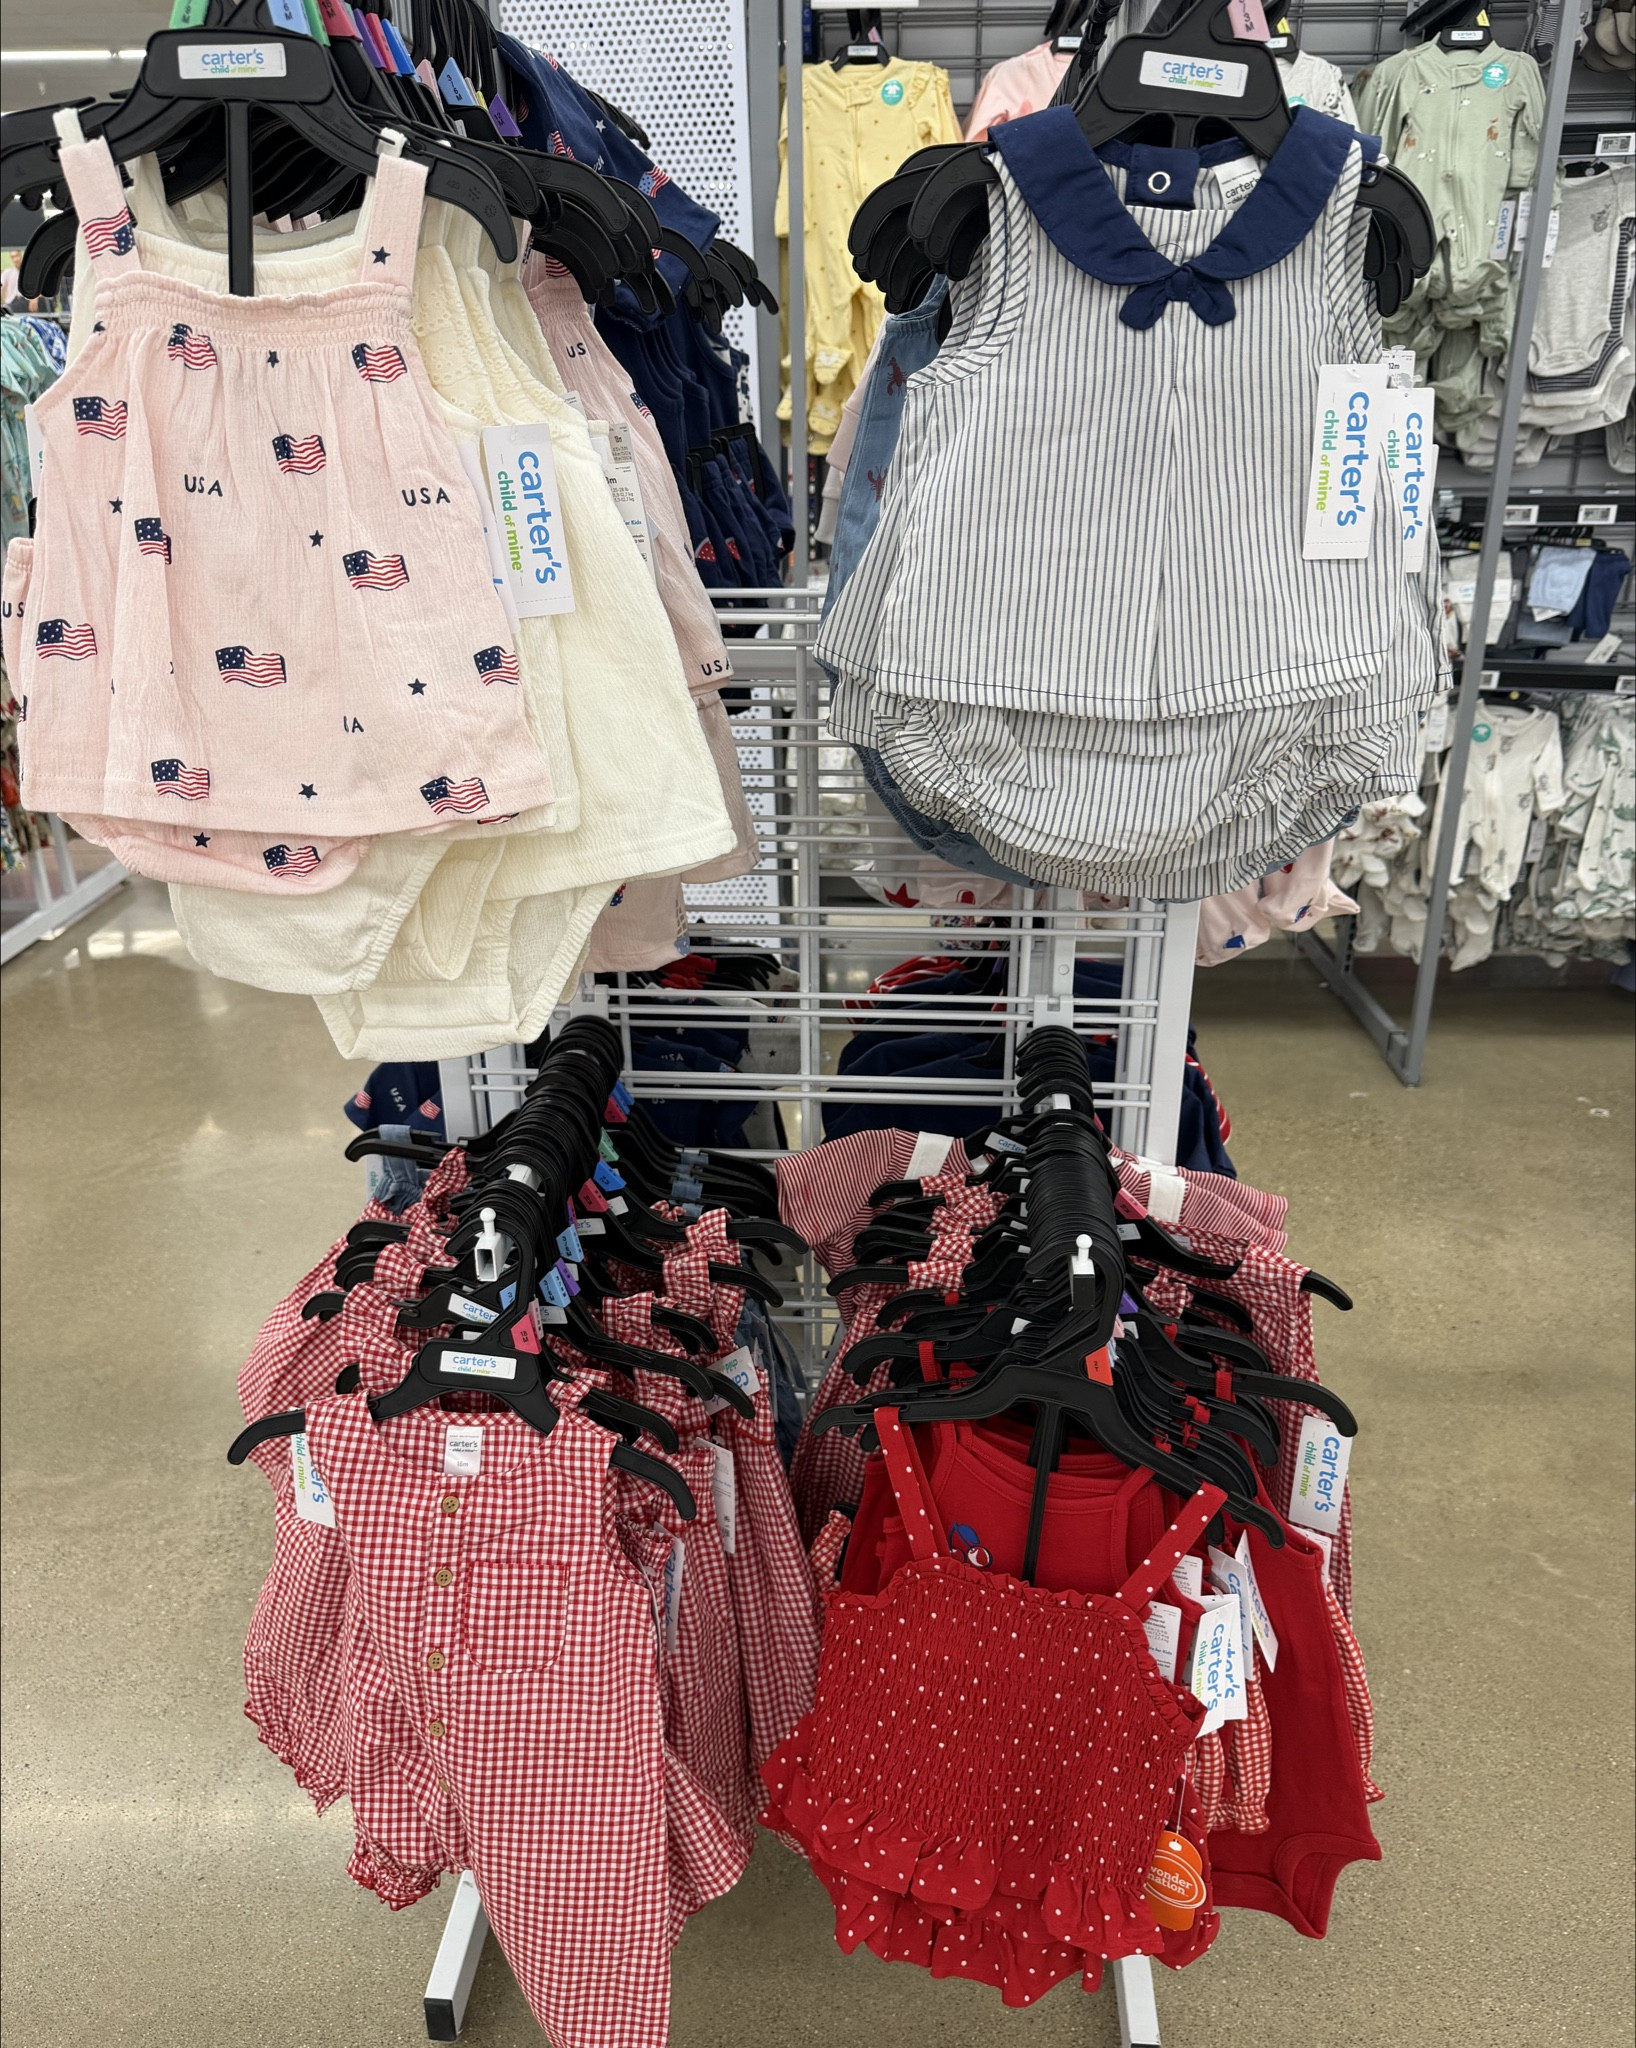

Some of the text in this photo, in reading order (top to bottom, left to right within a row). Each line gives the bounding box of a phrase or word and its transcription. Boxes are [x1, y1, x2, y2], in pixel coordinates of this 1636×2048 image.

[201, 48, 264, 65] carter's
[210, 65, 230, 73] child
[237, 65, 258, 73] mine
[1162, 61, 1224, 81] carter's
[1168, 75, 1188, 85] child
[1195, 79, 1216, 88] mine
[1496, 207, 1509, 250] carter's
[565, 342, 586, 358] US
[1315, 409, 1340, 511] child of mine
[1336, 391, 1370, 527] carter's
[1387, 429, 1400, 469] child
[184, 474, 223, 497] USA
[1402, 412, 1425, 541] carter's
[402, 487, 451, 507] USA
[497, 471, 523, 571] child of mine
[518, 451, 562, 584] carter's
[390, 1087, 407, 1112] USA
[452, 1356, 497, 1368] carter's
[457, 1365, 472, 1373] child
[296, 1434, 306, 1457] hild
[449, 1440, 478, 1448] carter's
[1304, 1441, 1317, 1466] child
[298, 1465, 307, 1490] mine
[1298, 1473, 1311, 1497] mine
[1314, 1436, 1340, 1512] carter's
[1198, 1640, 1207, 1666] child
[1207, 1623, 1224, 1712] carter's
[1147, 1873, 1186, 1896] nation
